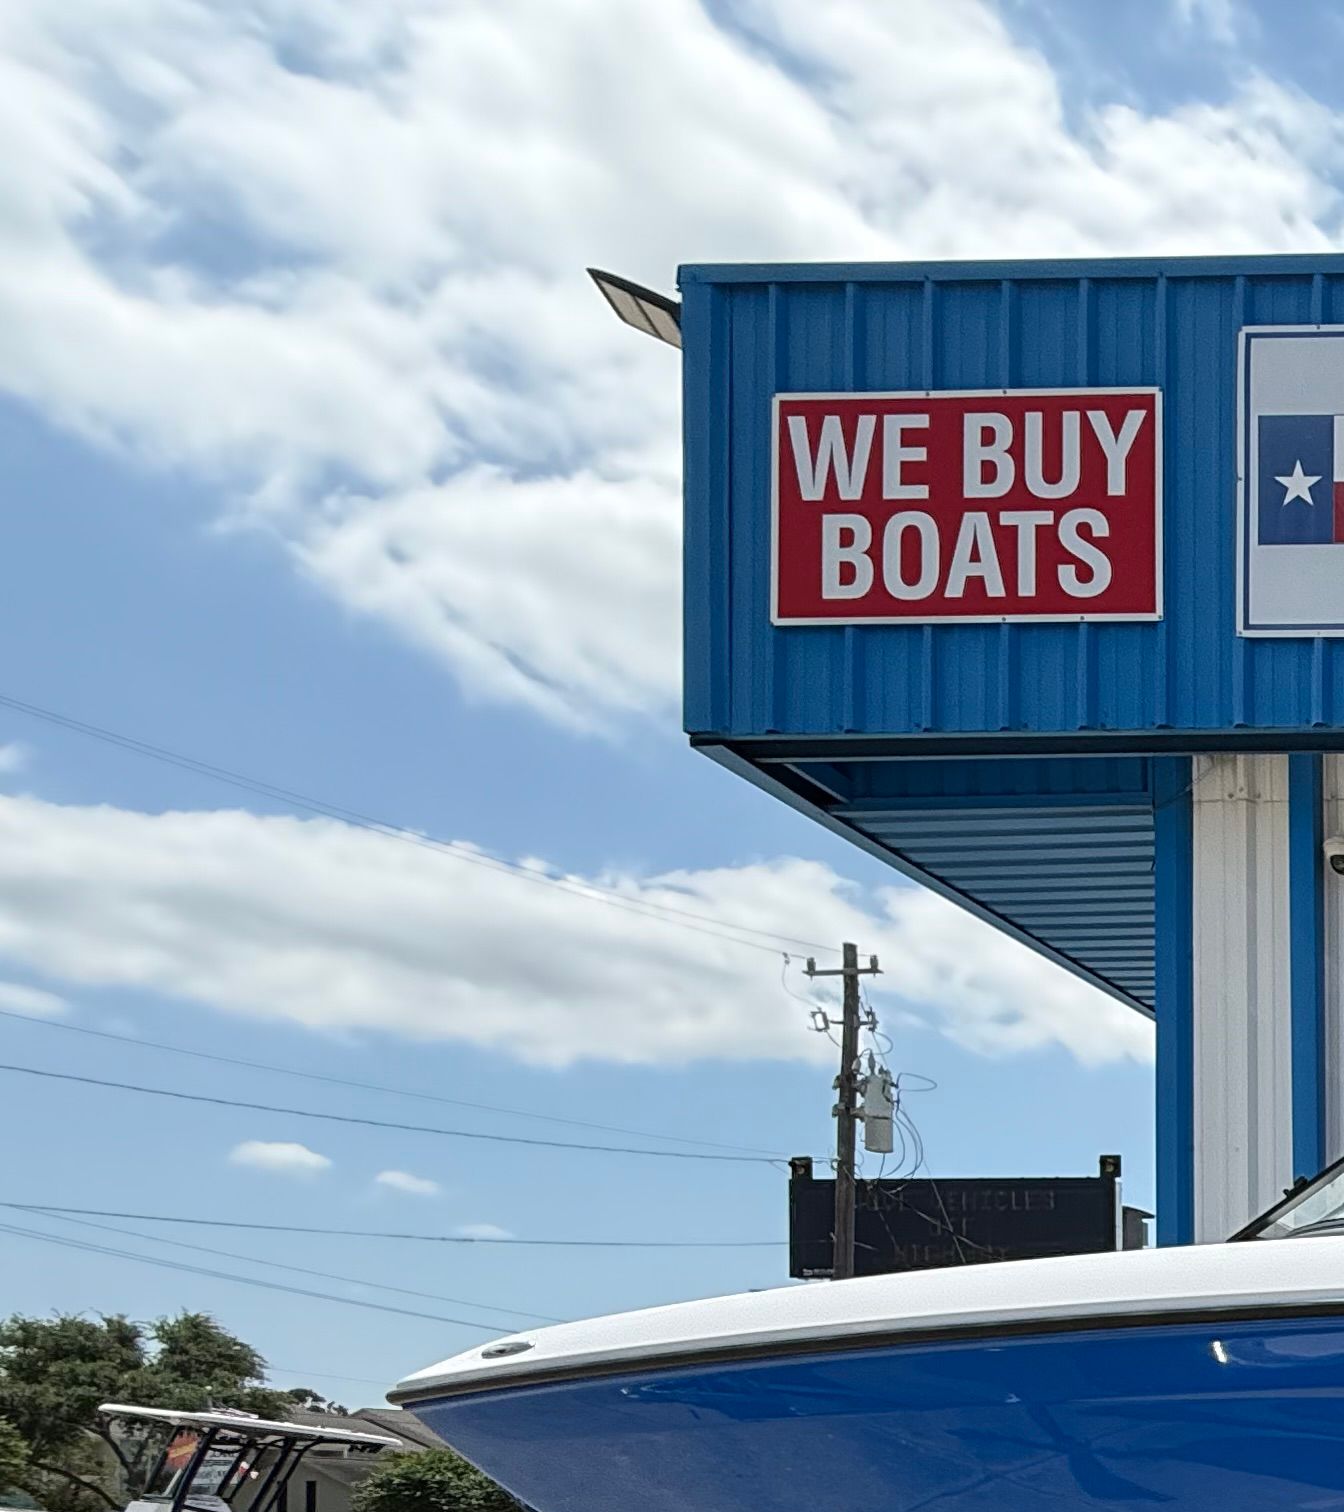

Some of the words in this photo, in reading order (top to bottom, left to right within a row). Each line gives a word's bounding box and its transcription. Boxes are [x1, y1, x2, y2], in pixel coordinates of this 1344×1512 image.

[788, 413, 930, 502] WE
[963, 409, 1147, 500] BUY
[821, 508, 1112, 600] BOATS
